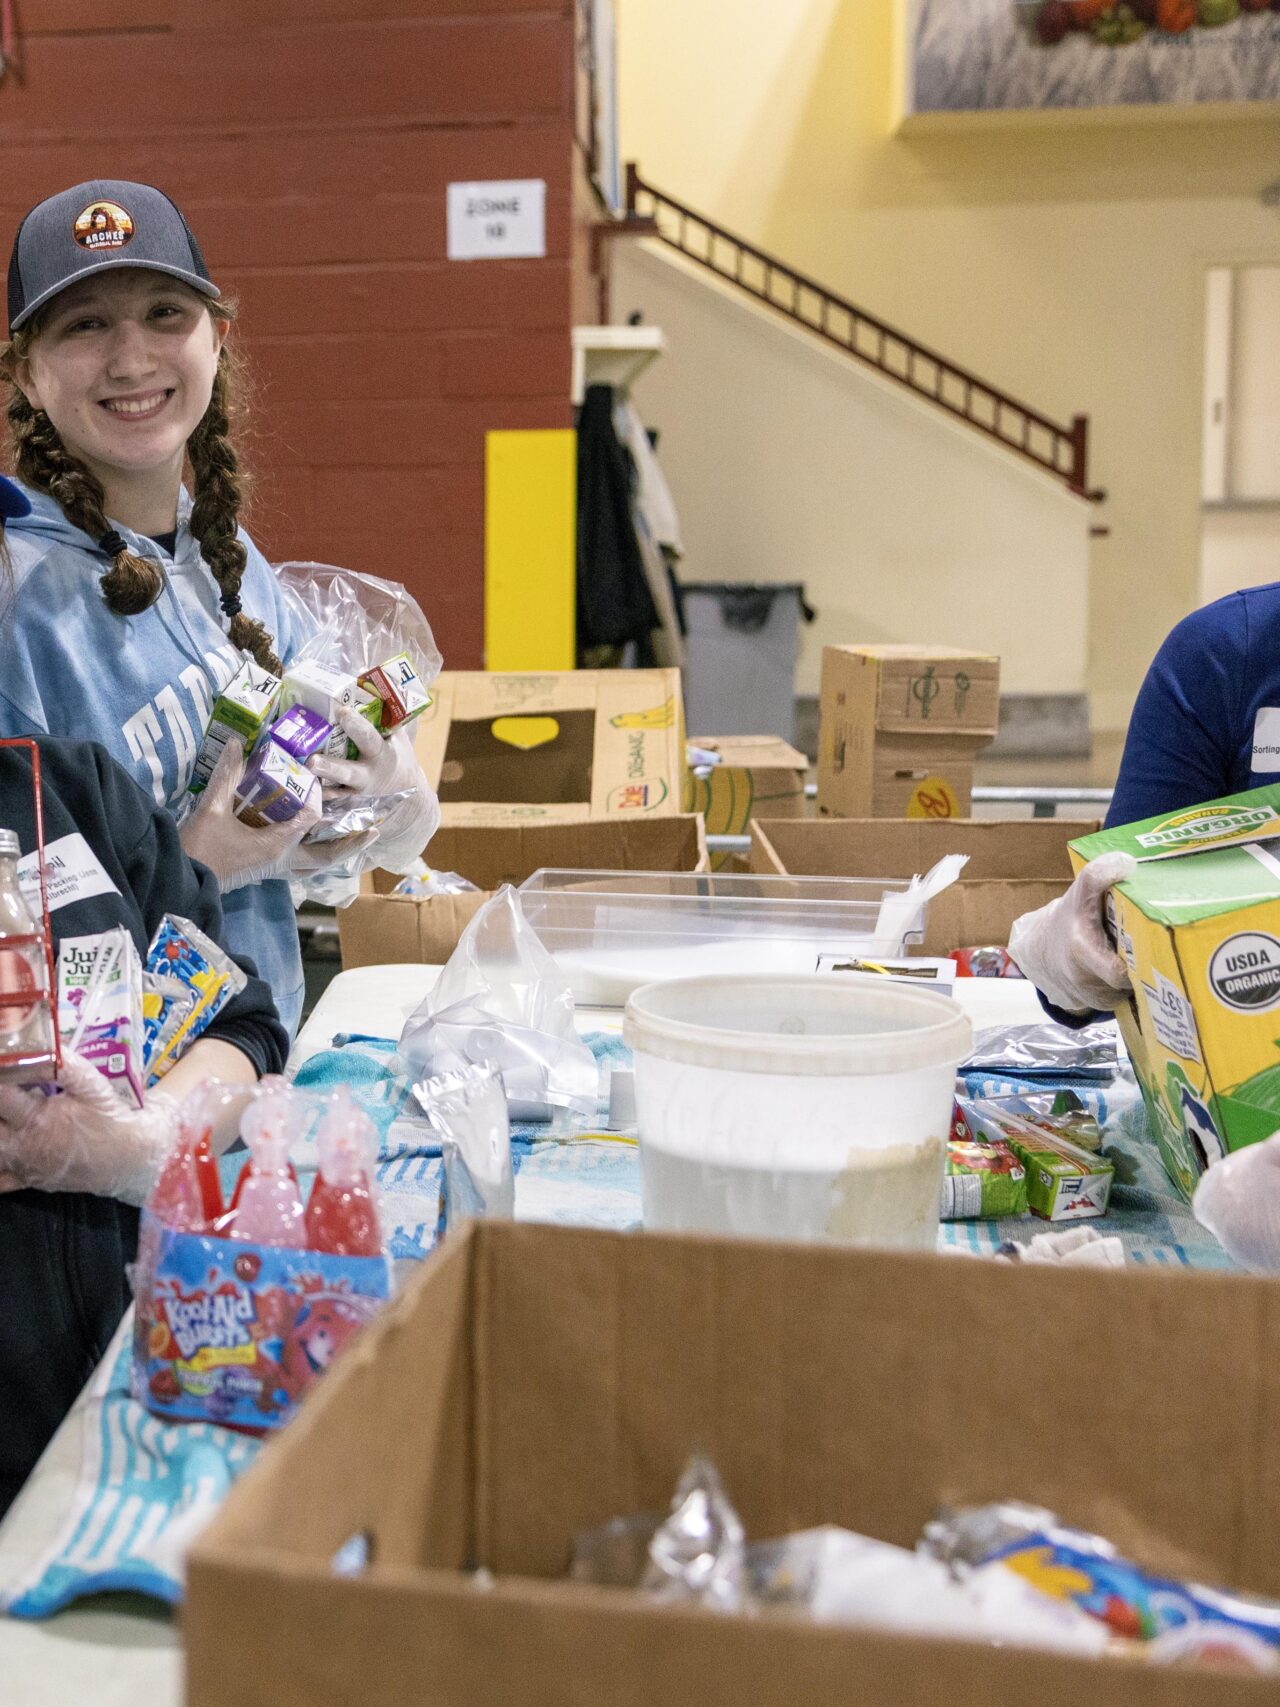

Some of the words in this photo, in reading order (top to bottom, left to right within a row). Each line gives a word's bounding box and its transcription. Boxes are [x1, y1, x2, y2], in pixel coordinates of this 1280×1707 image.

[85, 230, 125, 244] ARCHES
[1144, 811, 1273, 844] ORGANIC
[47, 875, 78, 890] Packing
[1225, 949, 1271, 973] USDA
[1224, 970, 1280, 994] ORGANIC
